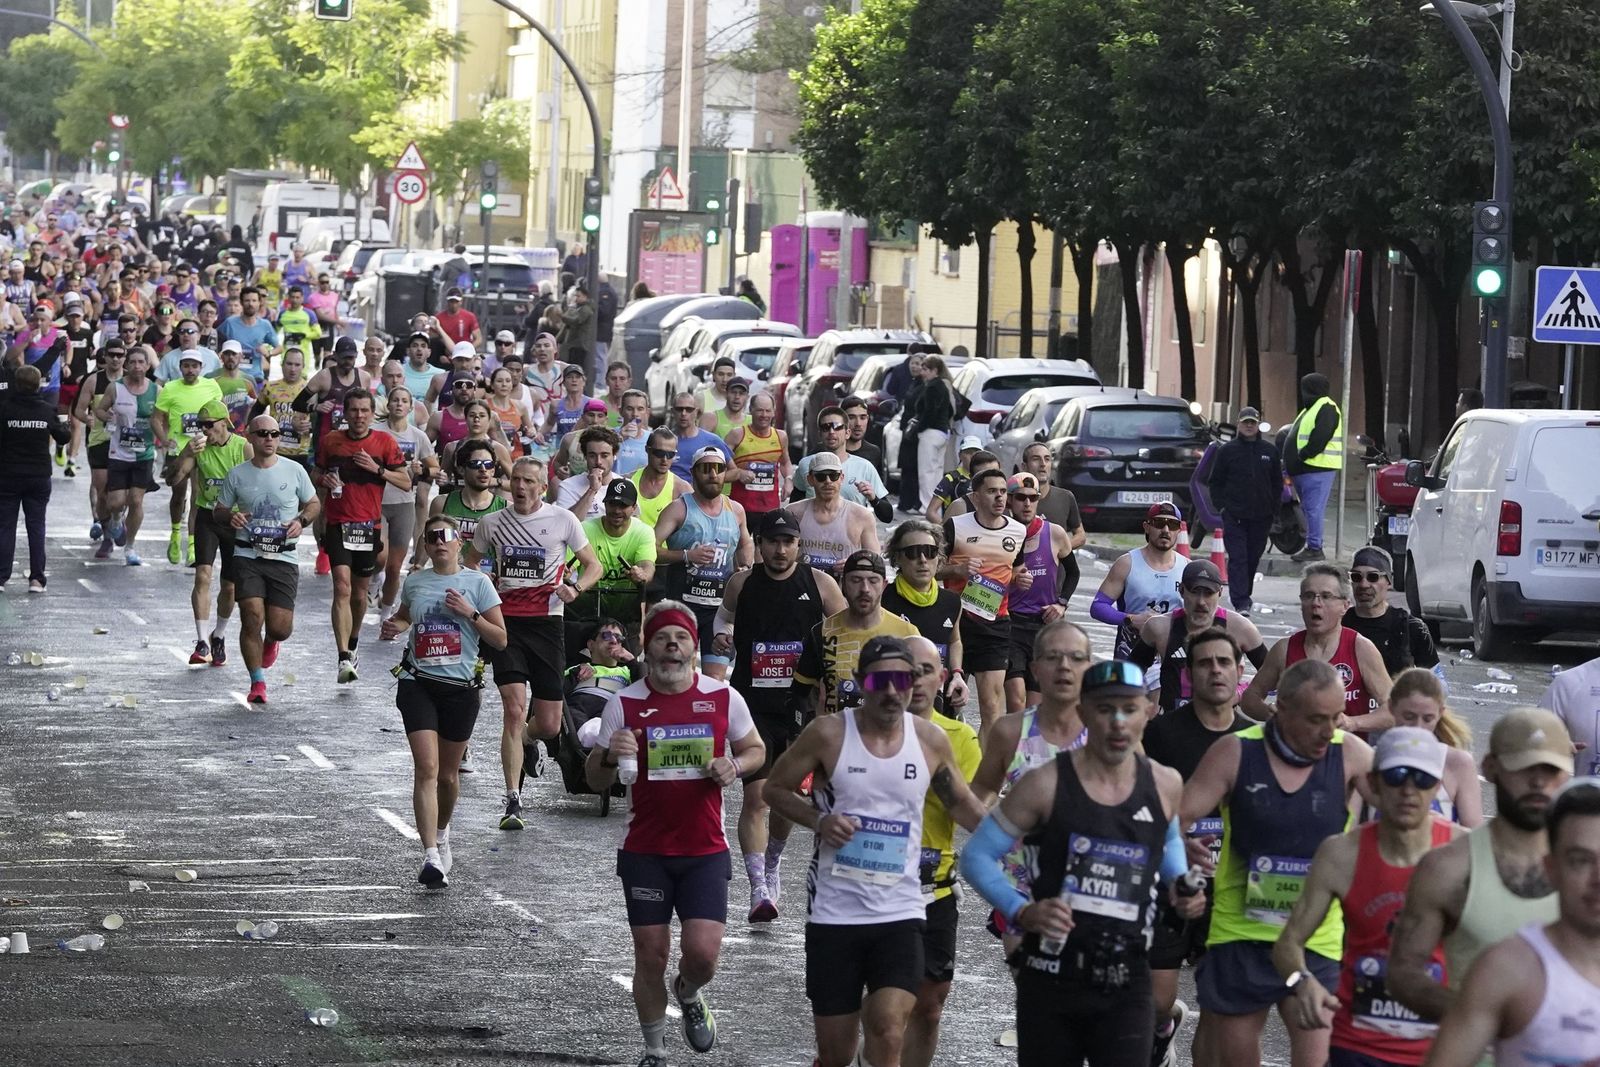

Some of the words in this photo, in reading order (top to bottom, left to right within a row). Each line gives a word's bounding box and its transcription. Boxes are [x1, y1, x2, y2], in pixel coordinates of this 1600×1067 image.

[401, 182, 420, 193] 30
[7, 420, 48, 428] VOLUNTEER
[1125, 493, 1150, 502] 4249
[1545, 551, 1575, 563] 9177
[1579, 552, 1600, 564] MFY
[506, 568, 539, 578] MARTEL
[983, 580, 1004, 592] ZURICH
[691, 587, 717, 597] EDGAR
[425, 645, 449, 656] JANA
[760, 667, 784, 677] JOSE
[669, 728, 706, 737] ZURICH
[660, 752, 702, 767] JULIÁN
[865, 821, 903, 833] ZURICH
[1081, 876, 1118, 898] KYRI
